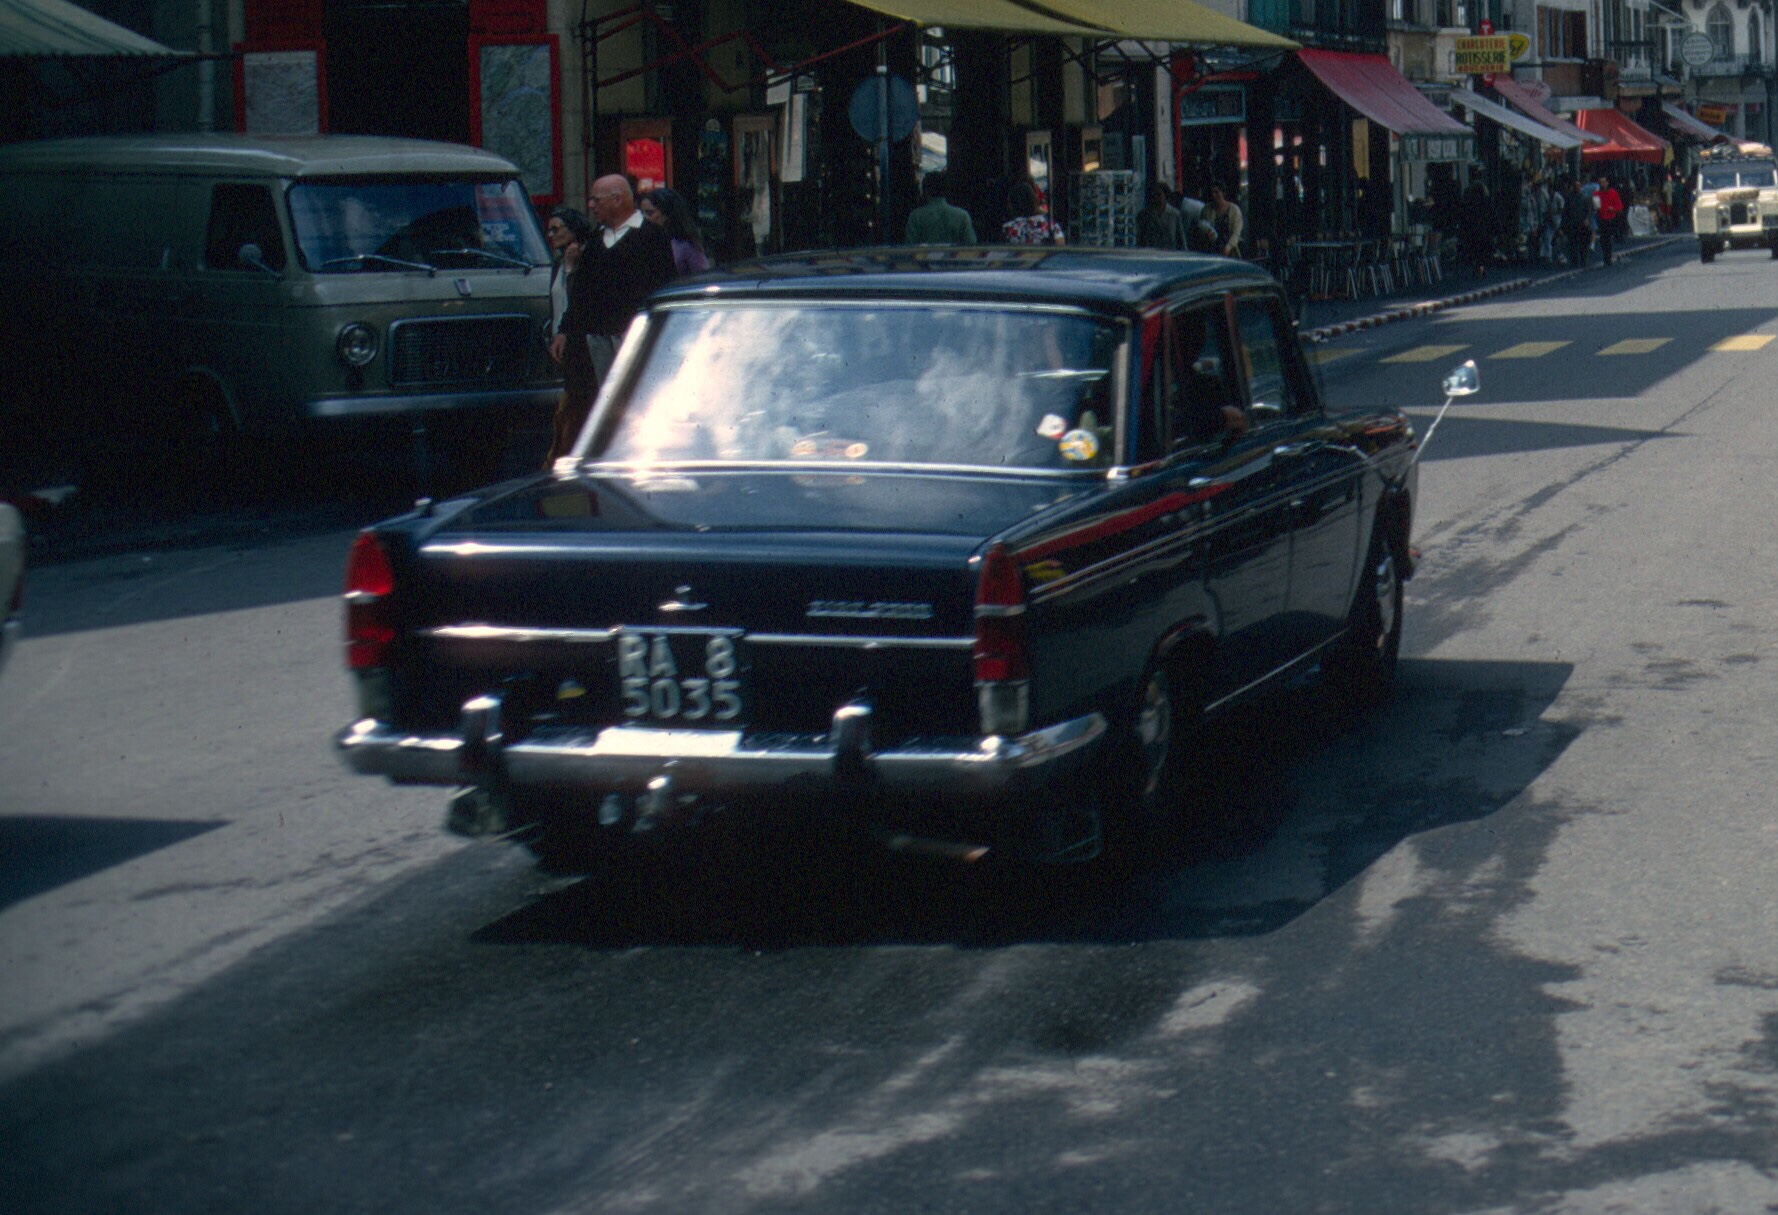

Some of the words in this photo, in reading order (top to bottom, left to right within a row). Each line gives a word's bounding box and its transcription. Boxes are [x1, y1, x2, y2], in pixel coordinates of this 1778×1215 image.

[618, 634, 678, 678] RA
[704, 635, 738, 679] 8
[619, 677, 743, 721] 5035
